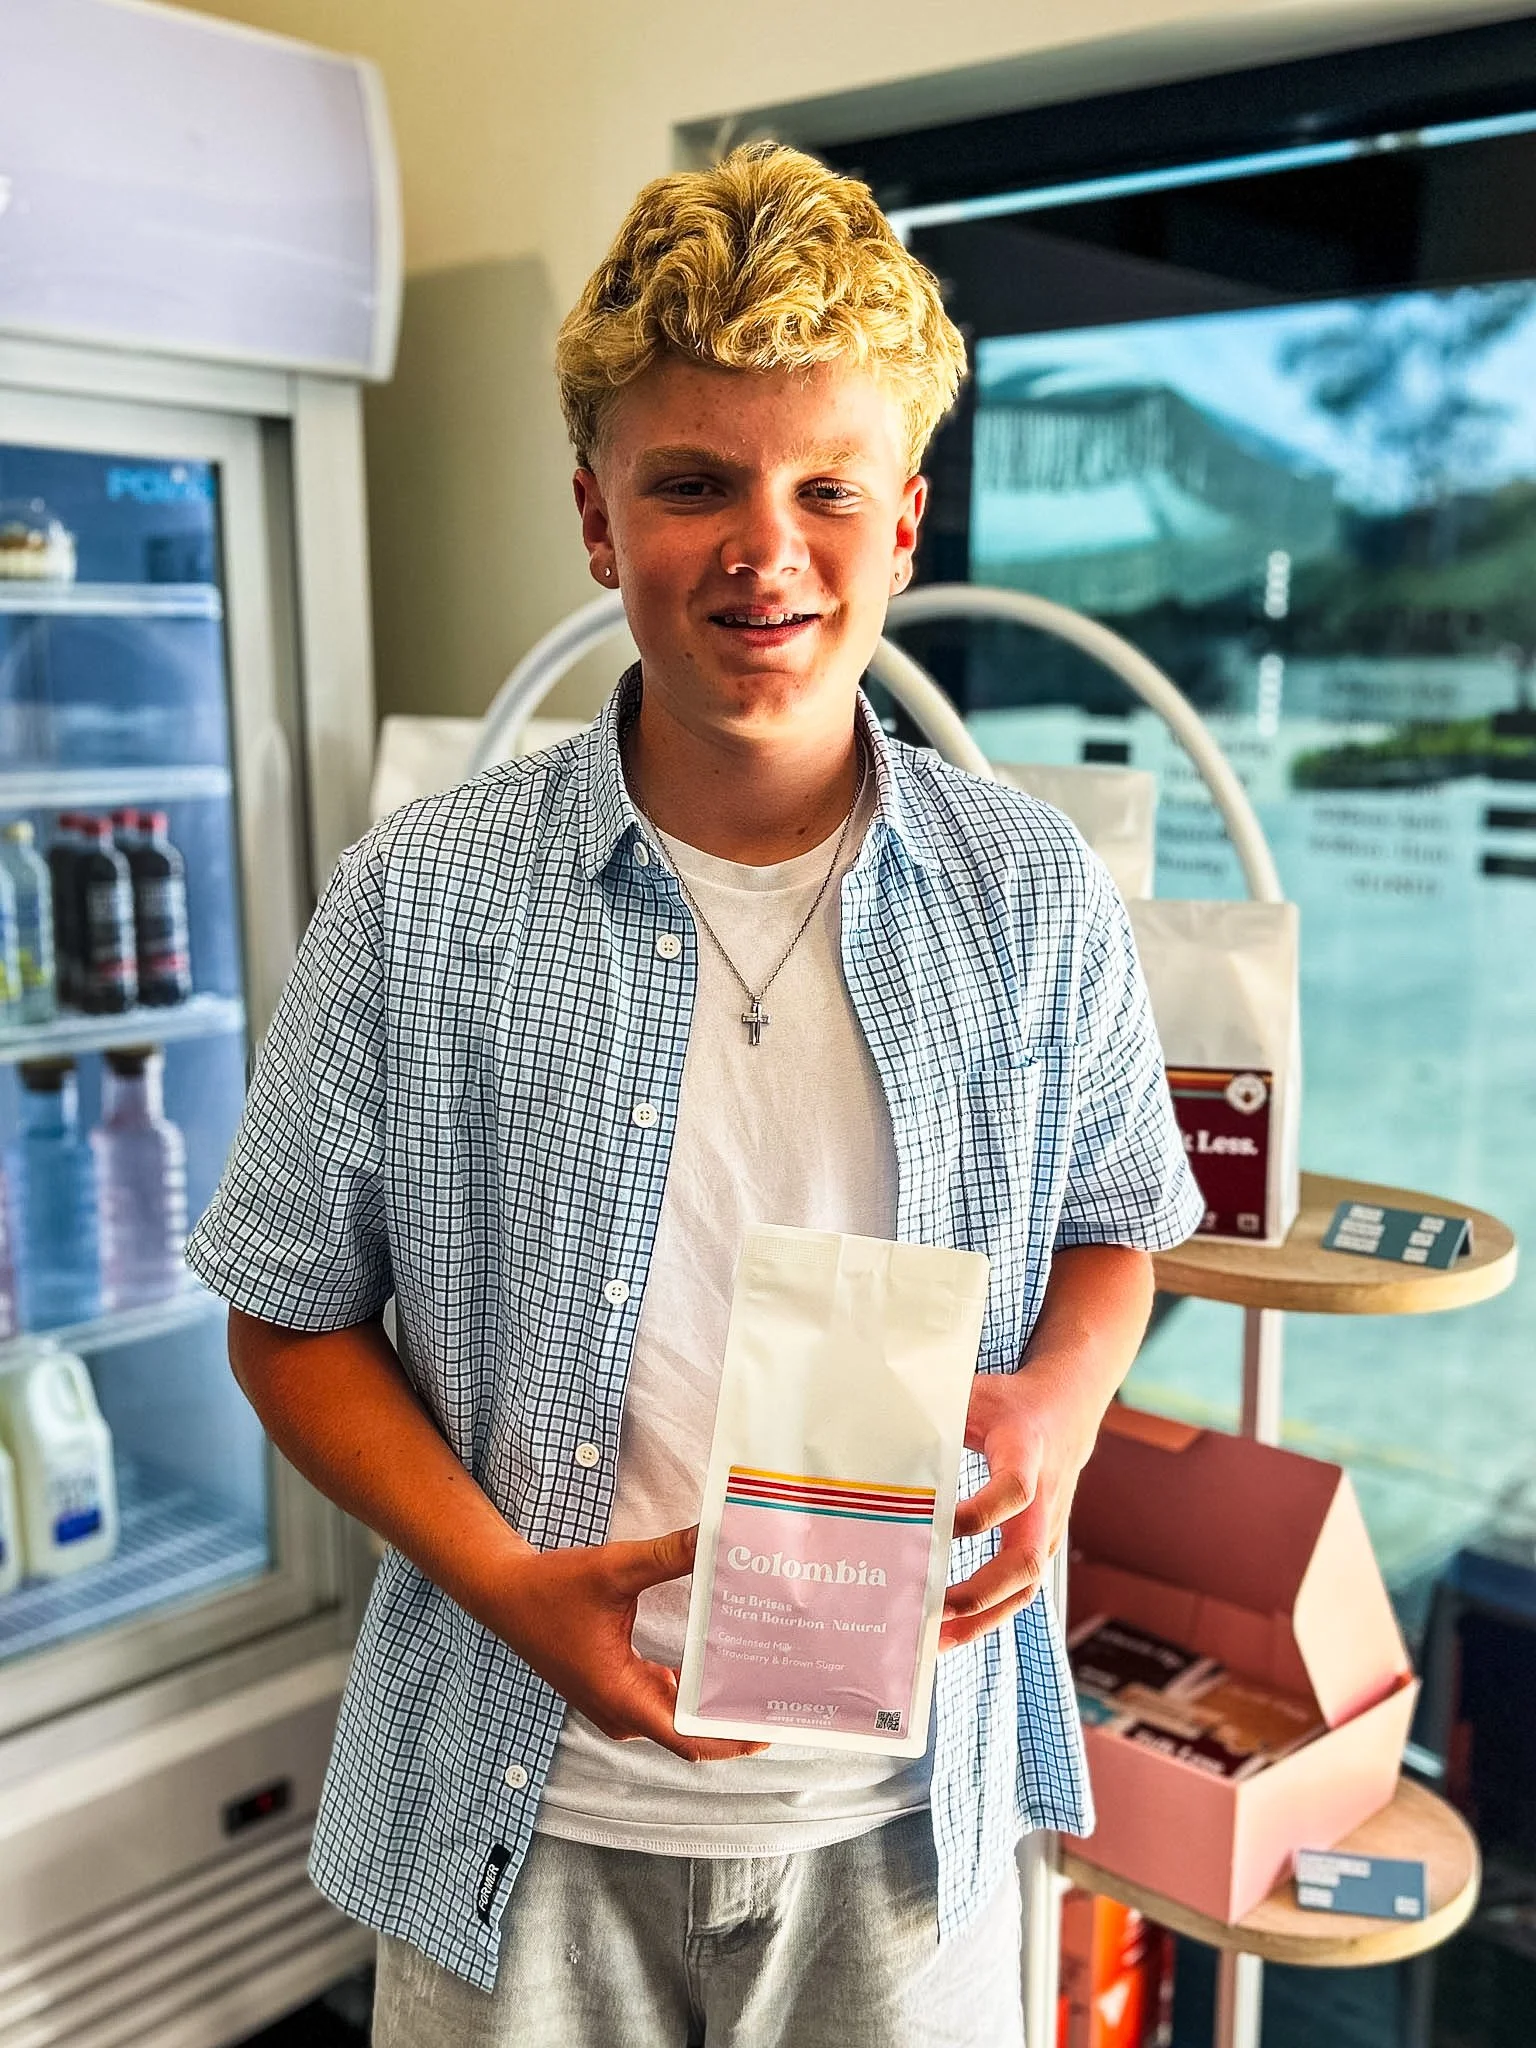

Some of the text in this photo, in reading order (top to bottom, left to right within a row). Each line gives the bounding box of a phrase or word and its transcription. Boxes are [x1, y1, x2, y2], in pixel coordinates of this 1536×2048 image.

[727, 1545, 888, 1587] Colombia
[722, 1590, 793, 1612] Las Brisas
[720, 1604, 888, 1634] Sidra Bourbon Natural
[718, 1631, 792, 1652] Condensed Milk
[716, 1646, 846, 1671] Strawberry & Brown Sugar
[766, 1699, 841, 1719] mosey
[478, 1863, 500, 1912] FORMER
